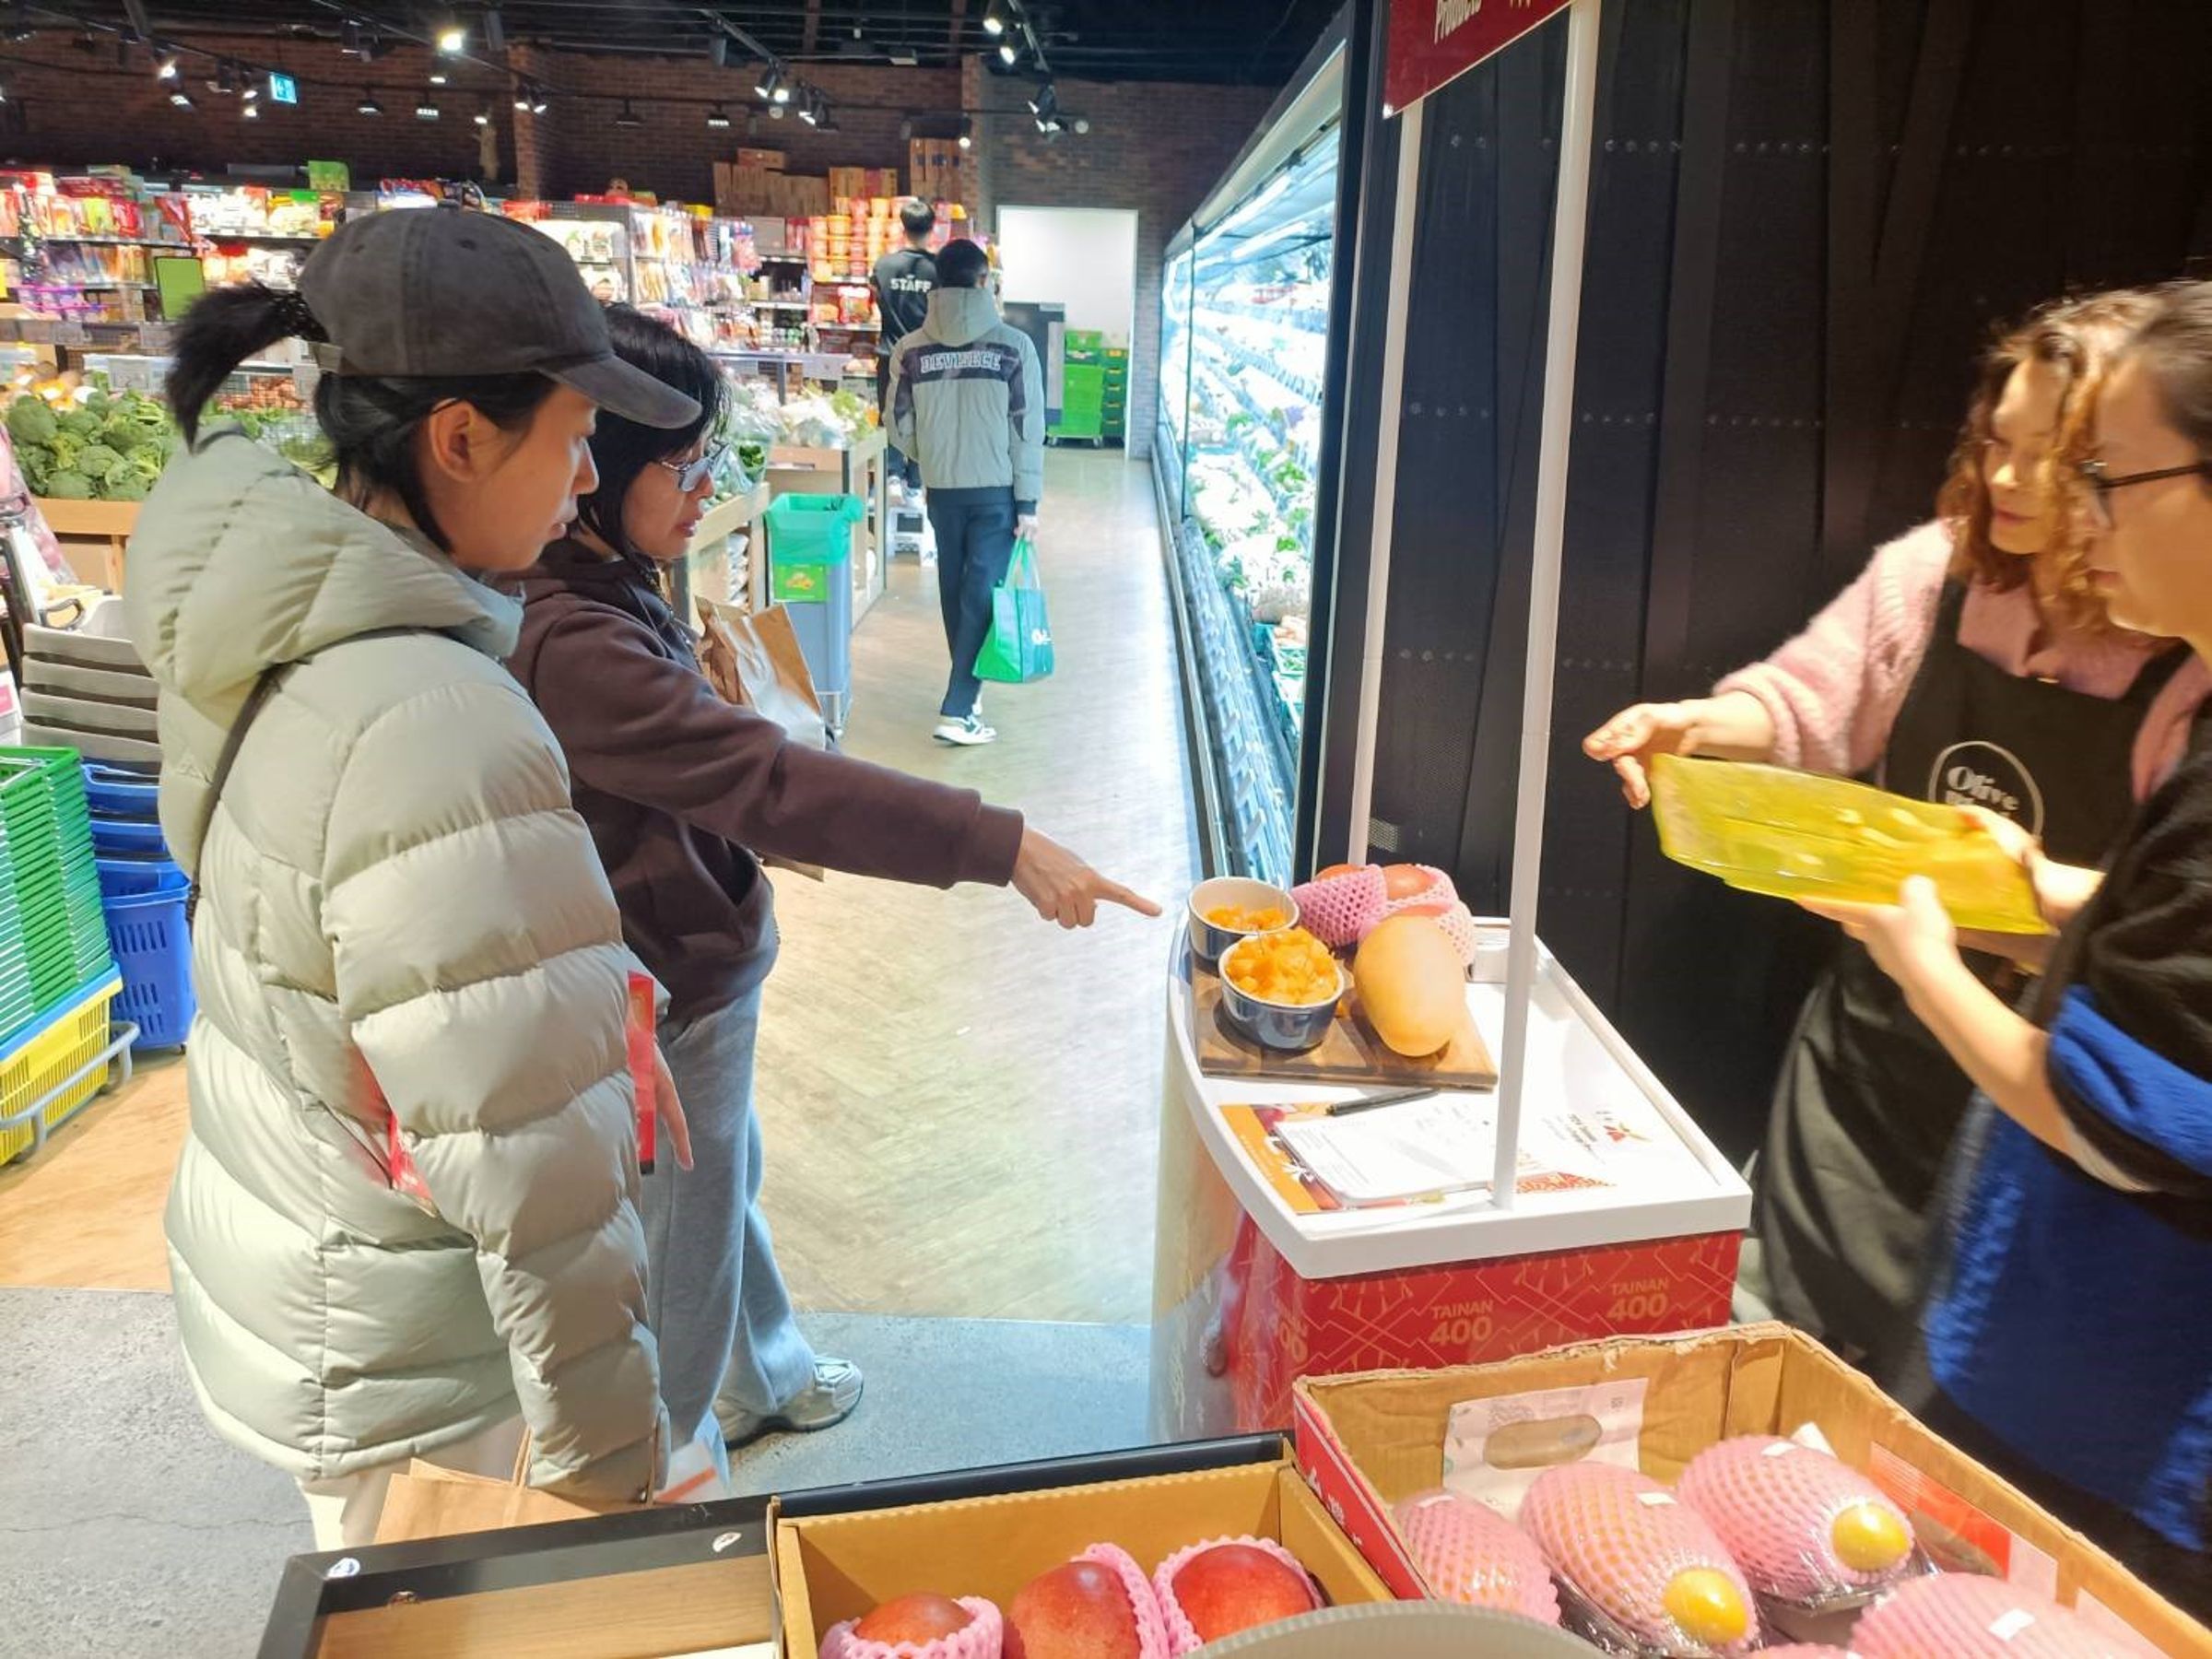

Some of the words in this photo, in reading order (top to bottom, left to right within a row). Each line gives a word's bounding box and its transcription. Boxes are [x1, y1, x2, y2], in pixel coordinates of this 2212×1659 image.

[890, 276, 932, 293] STAFF
[1947, 766, 2019, 811] Olive
[1614, 1277, 1669, 1296] TAINAN
[1431, 1300, 1494, 1320] TAINAN
[1607, 1292, 1668, 1322] 400
[1430, 1315, 1492, 1347] 400
